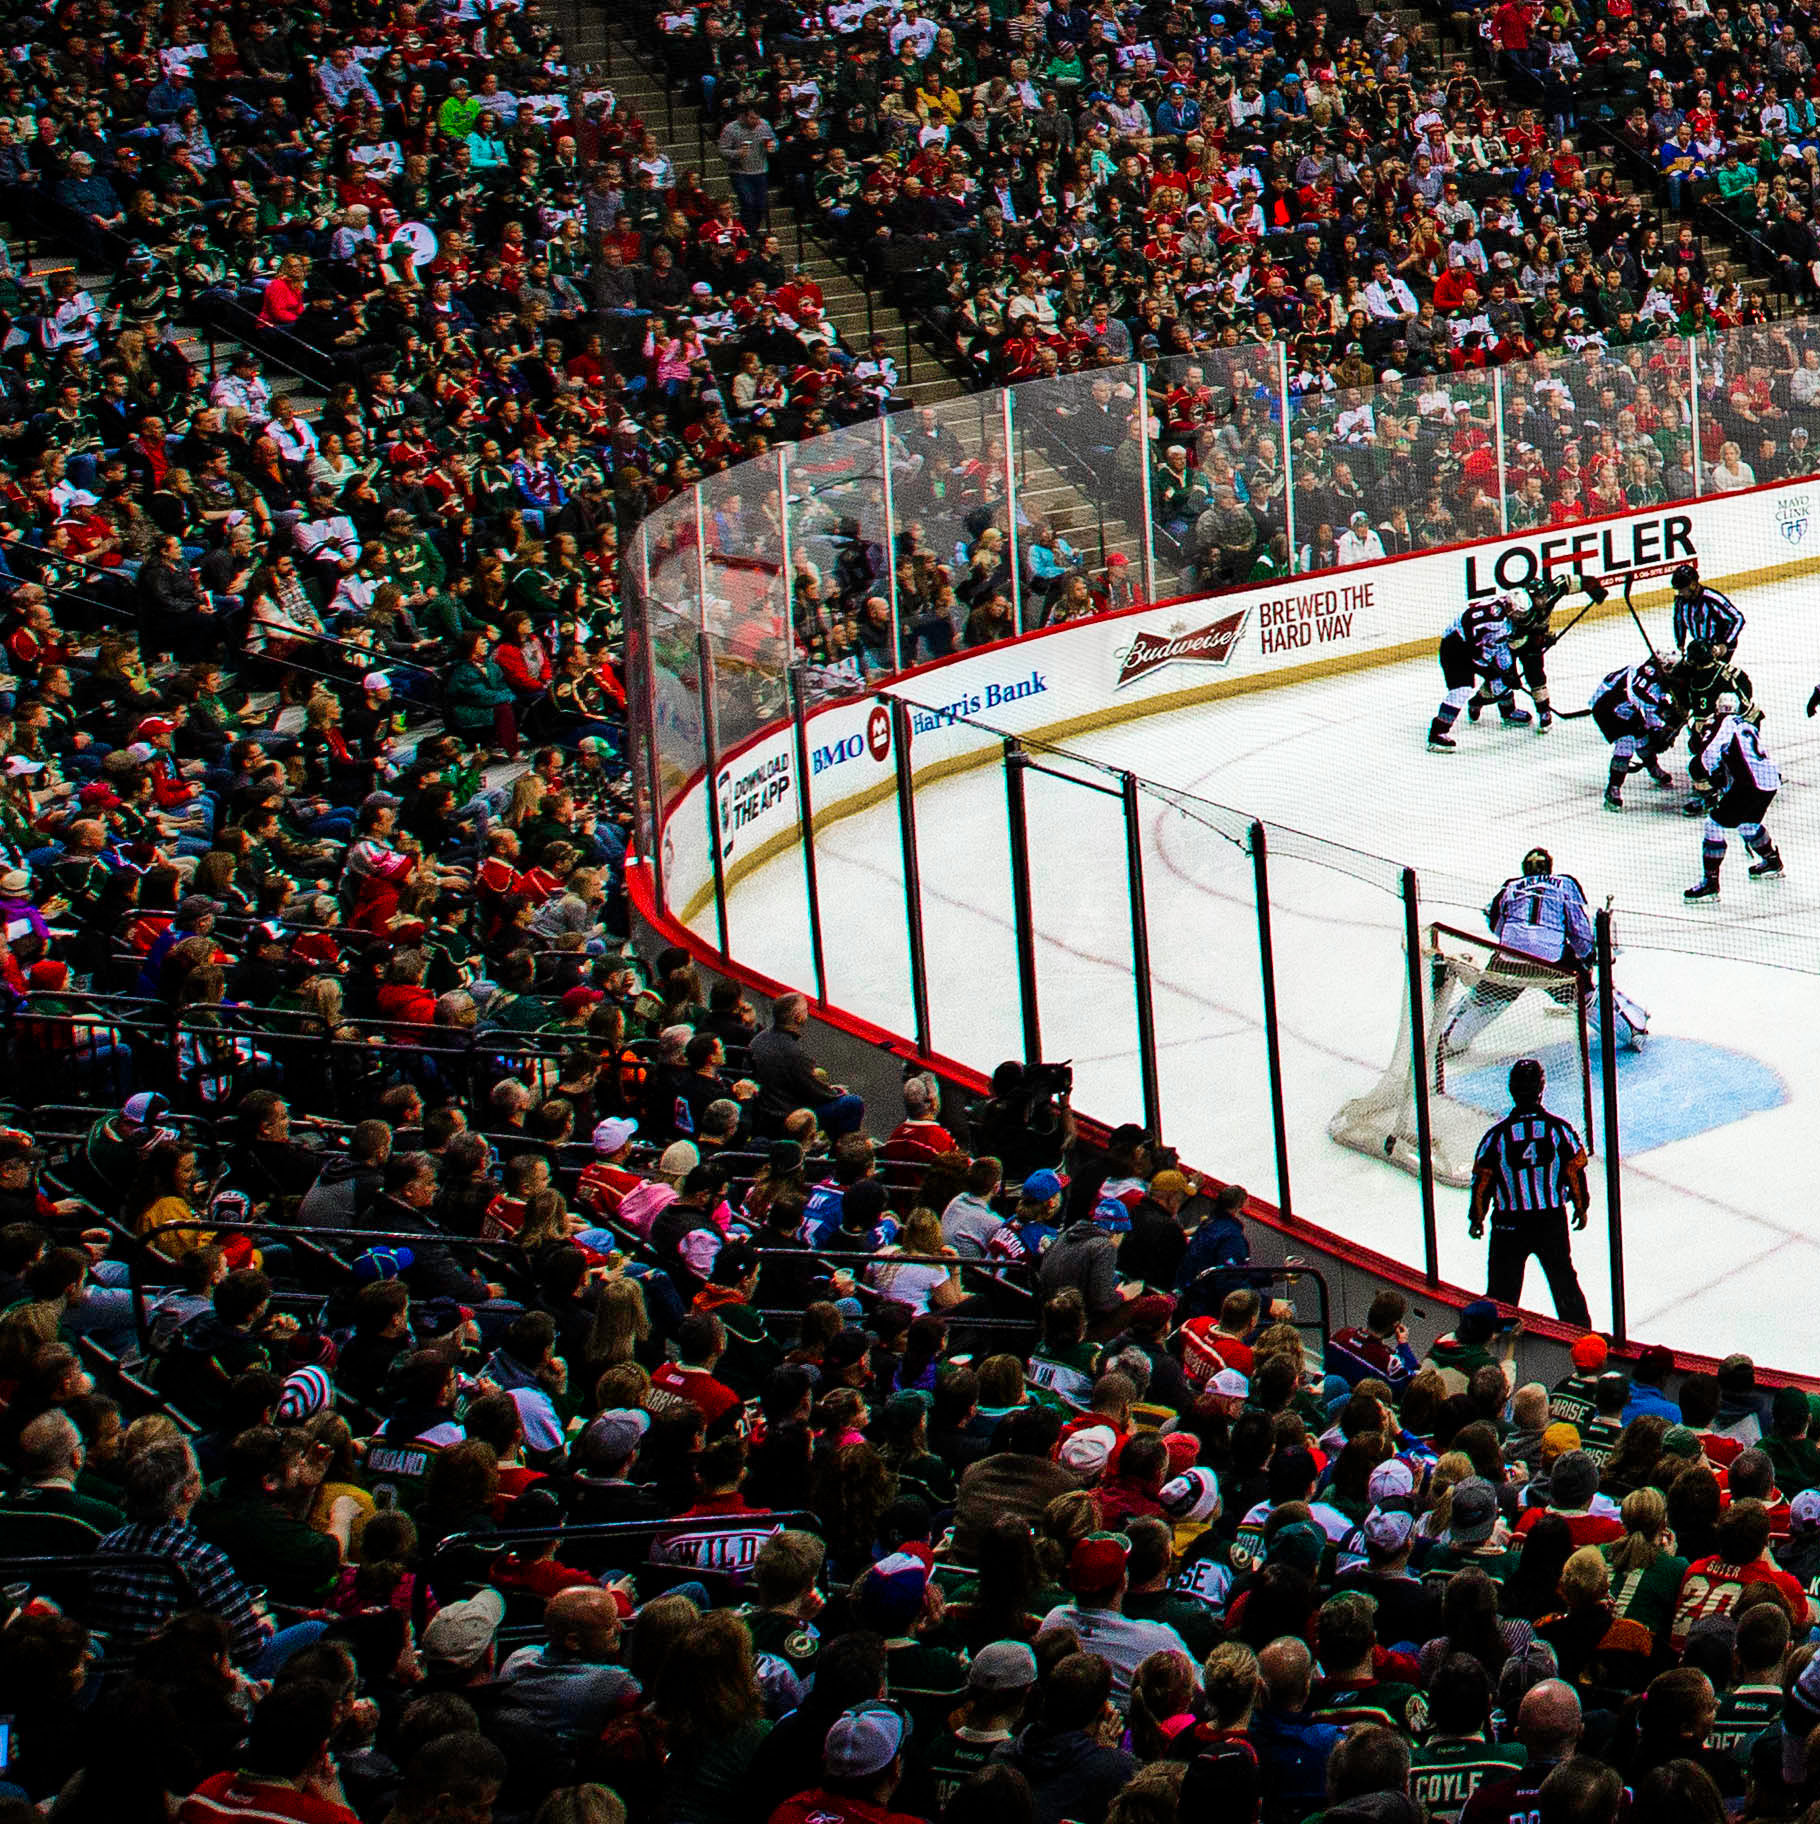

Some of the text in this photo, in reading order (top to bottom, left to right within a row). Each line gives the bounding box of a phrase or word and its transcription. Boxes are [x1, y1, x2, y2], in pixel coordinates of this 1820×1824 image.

[1465, 515, 1697, 600] LOFFLER
[1259, 582, 1375, 629] BREWED THE
[1113, 625, 1249, 670] Budweiser
[1260, 612, 1354, 655] HARD WAY
[912, 669, 1049, 736] Harris Bank
[733, 752, 791, 801] DOWNLOAD
[812, 733, 865, 776] BMO
[733, 775, 791, 830] THE APP
[1522, 1141, 1538, 1166] 4
[1415, 1770, 1483, 1803] COYLE
